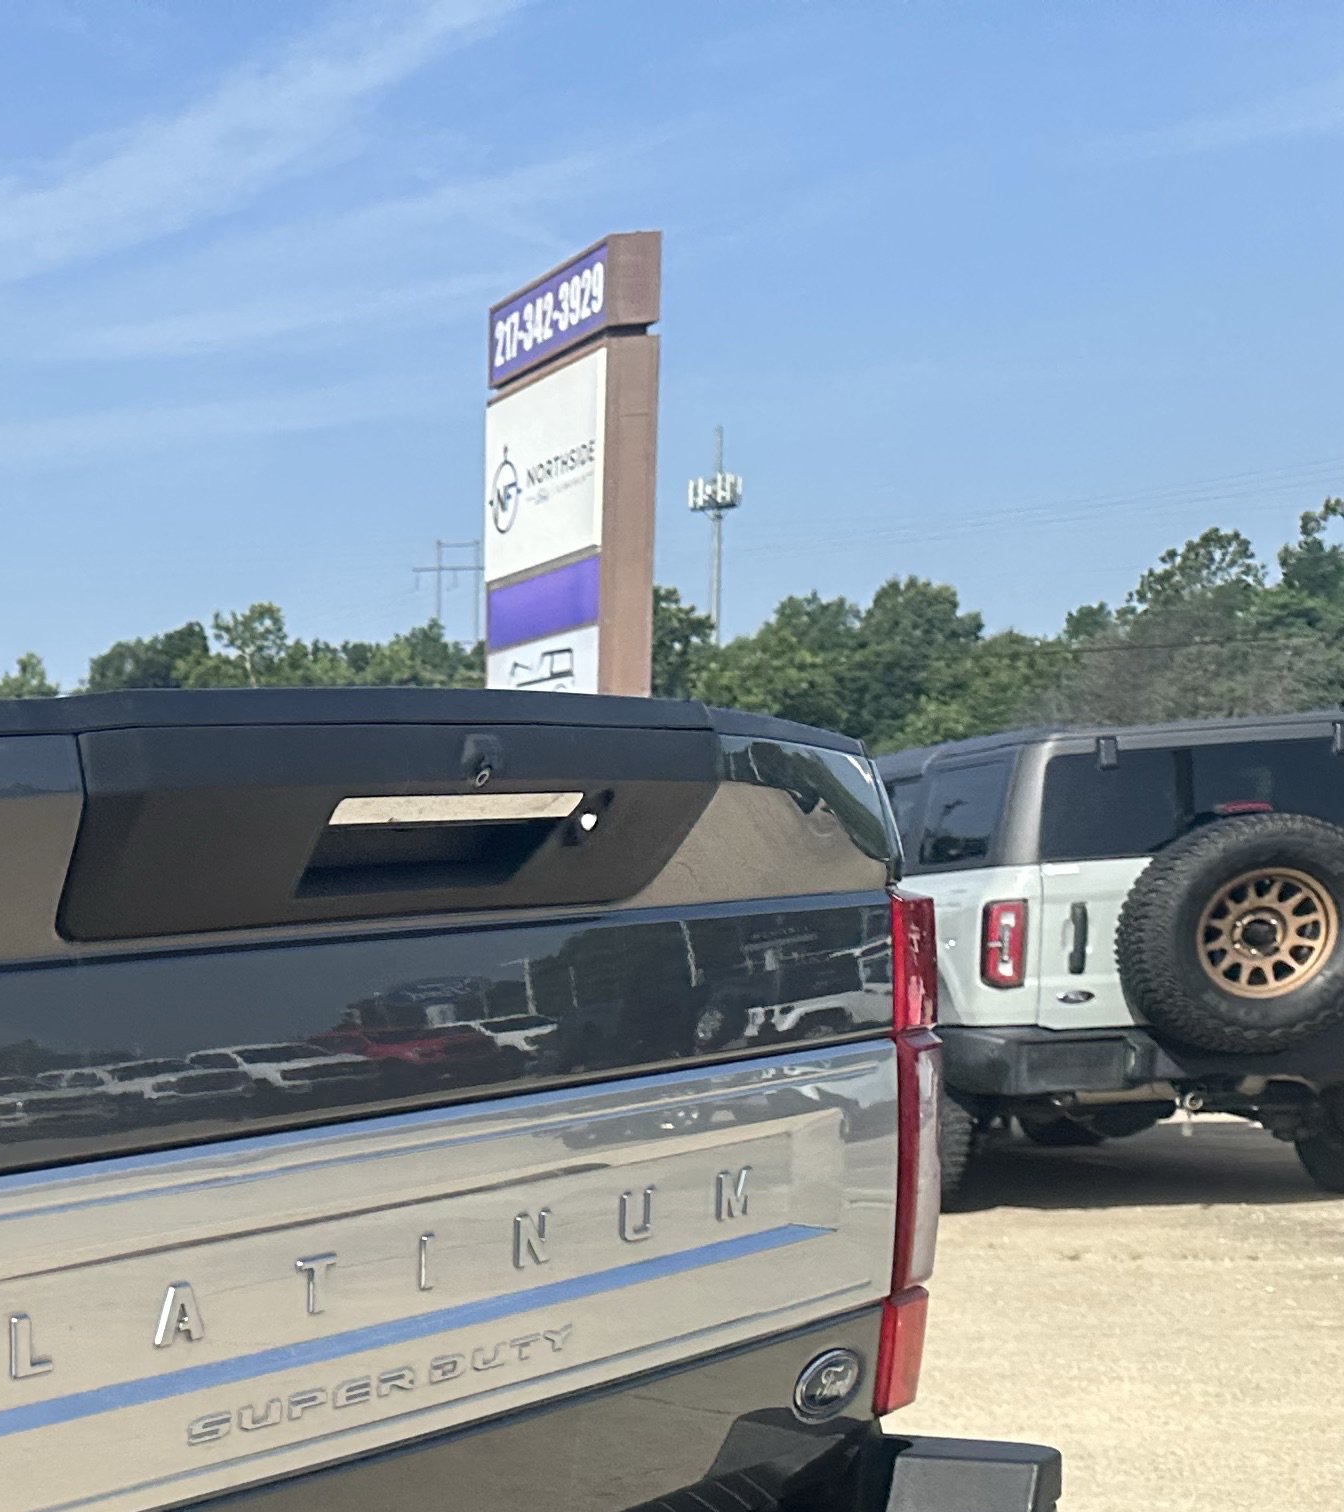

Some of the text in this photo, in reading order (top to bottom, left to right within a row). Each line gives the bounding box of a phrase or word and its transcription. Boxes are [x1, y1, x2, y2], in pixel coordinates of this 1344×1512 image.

[494, 262, 604, 367] 217-342-3929
[527, 440, 595, 488] NORTHSIDE
[187, 1323, 573, 1446] SUPER DUTY
